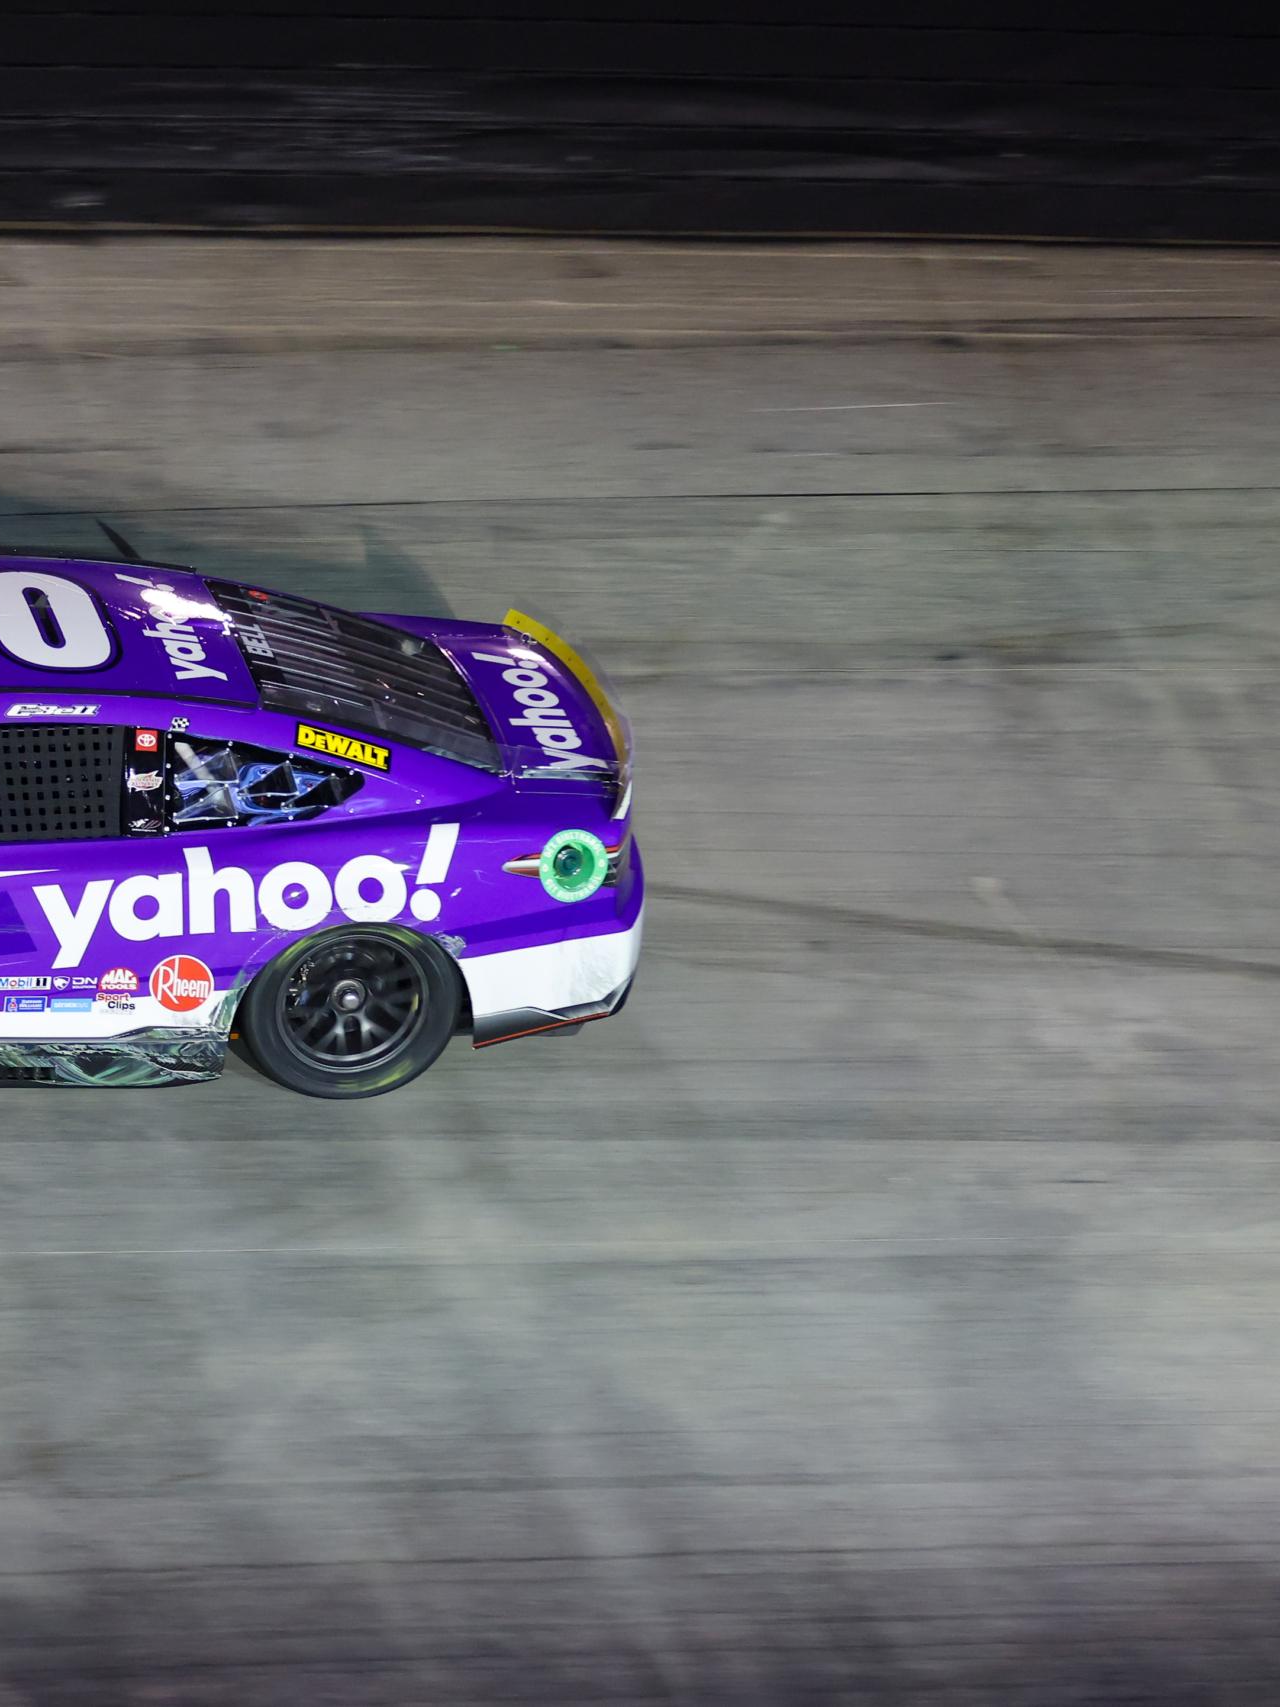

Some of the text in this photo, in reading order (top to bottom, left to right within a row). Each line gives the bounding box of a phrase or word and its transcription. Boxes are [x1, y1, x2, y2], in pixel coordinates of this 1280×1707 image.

[470, 651, 609, 770] yahoo!
[31, 822, 461, 970] yahoo!
[72, 976, 98, 985] DN
[101, 968, 138, 984] MAC
[157, 957, 211, 1005] Rheem
[97, 993, 130, 1002] Sport
[107, 1001, 136, 1010] Clips
